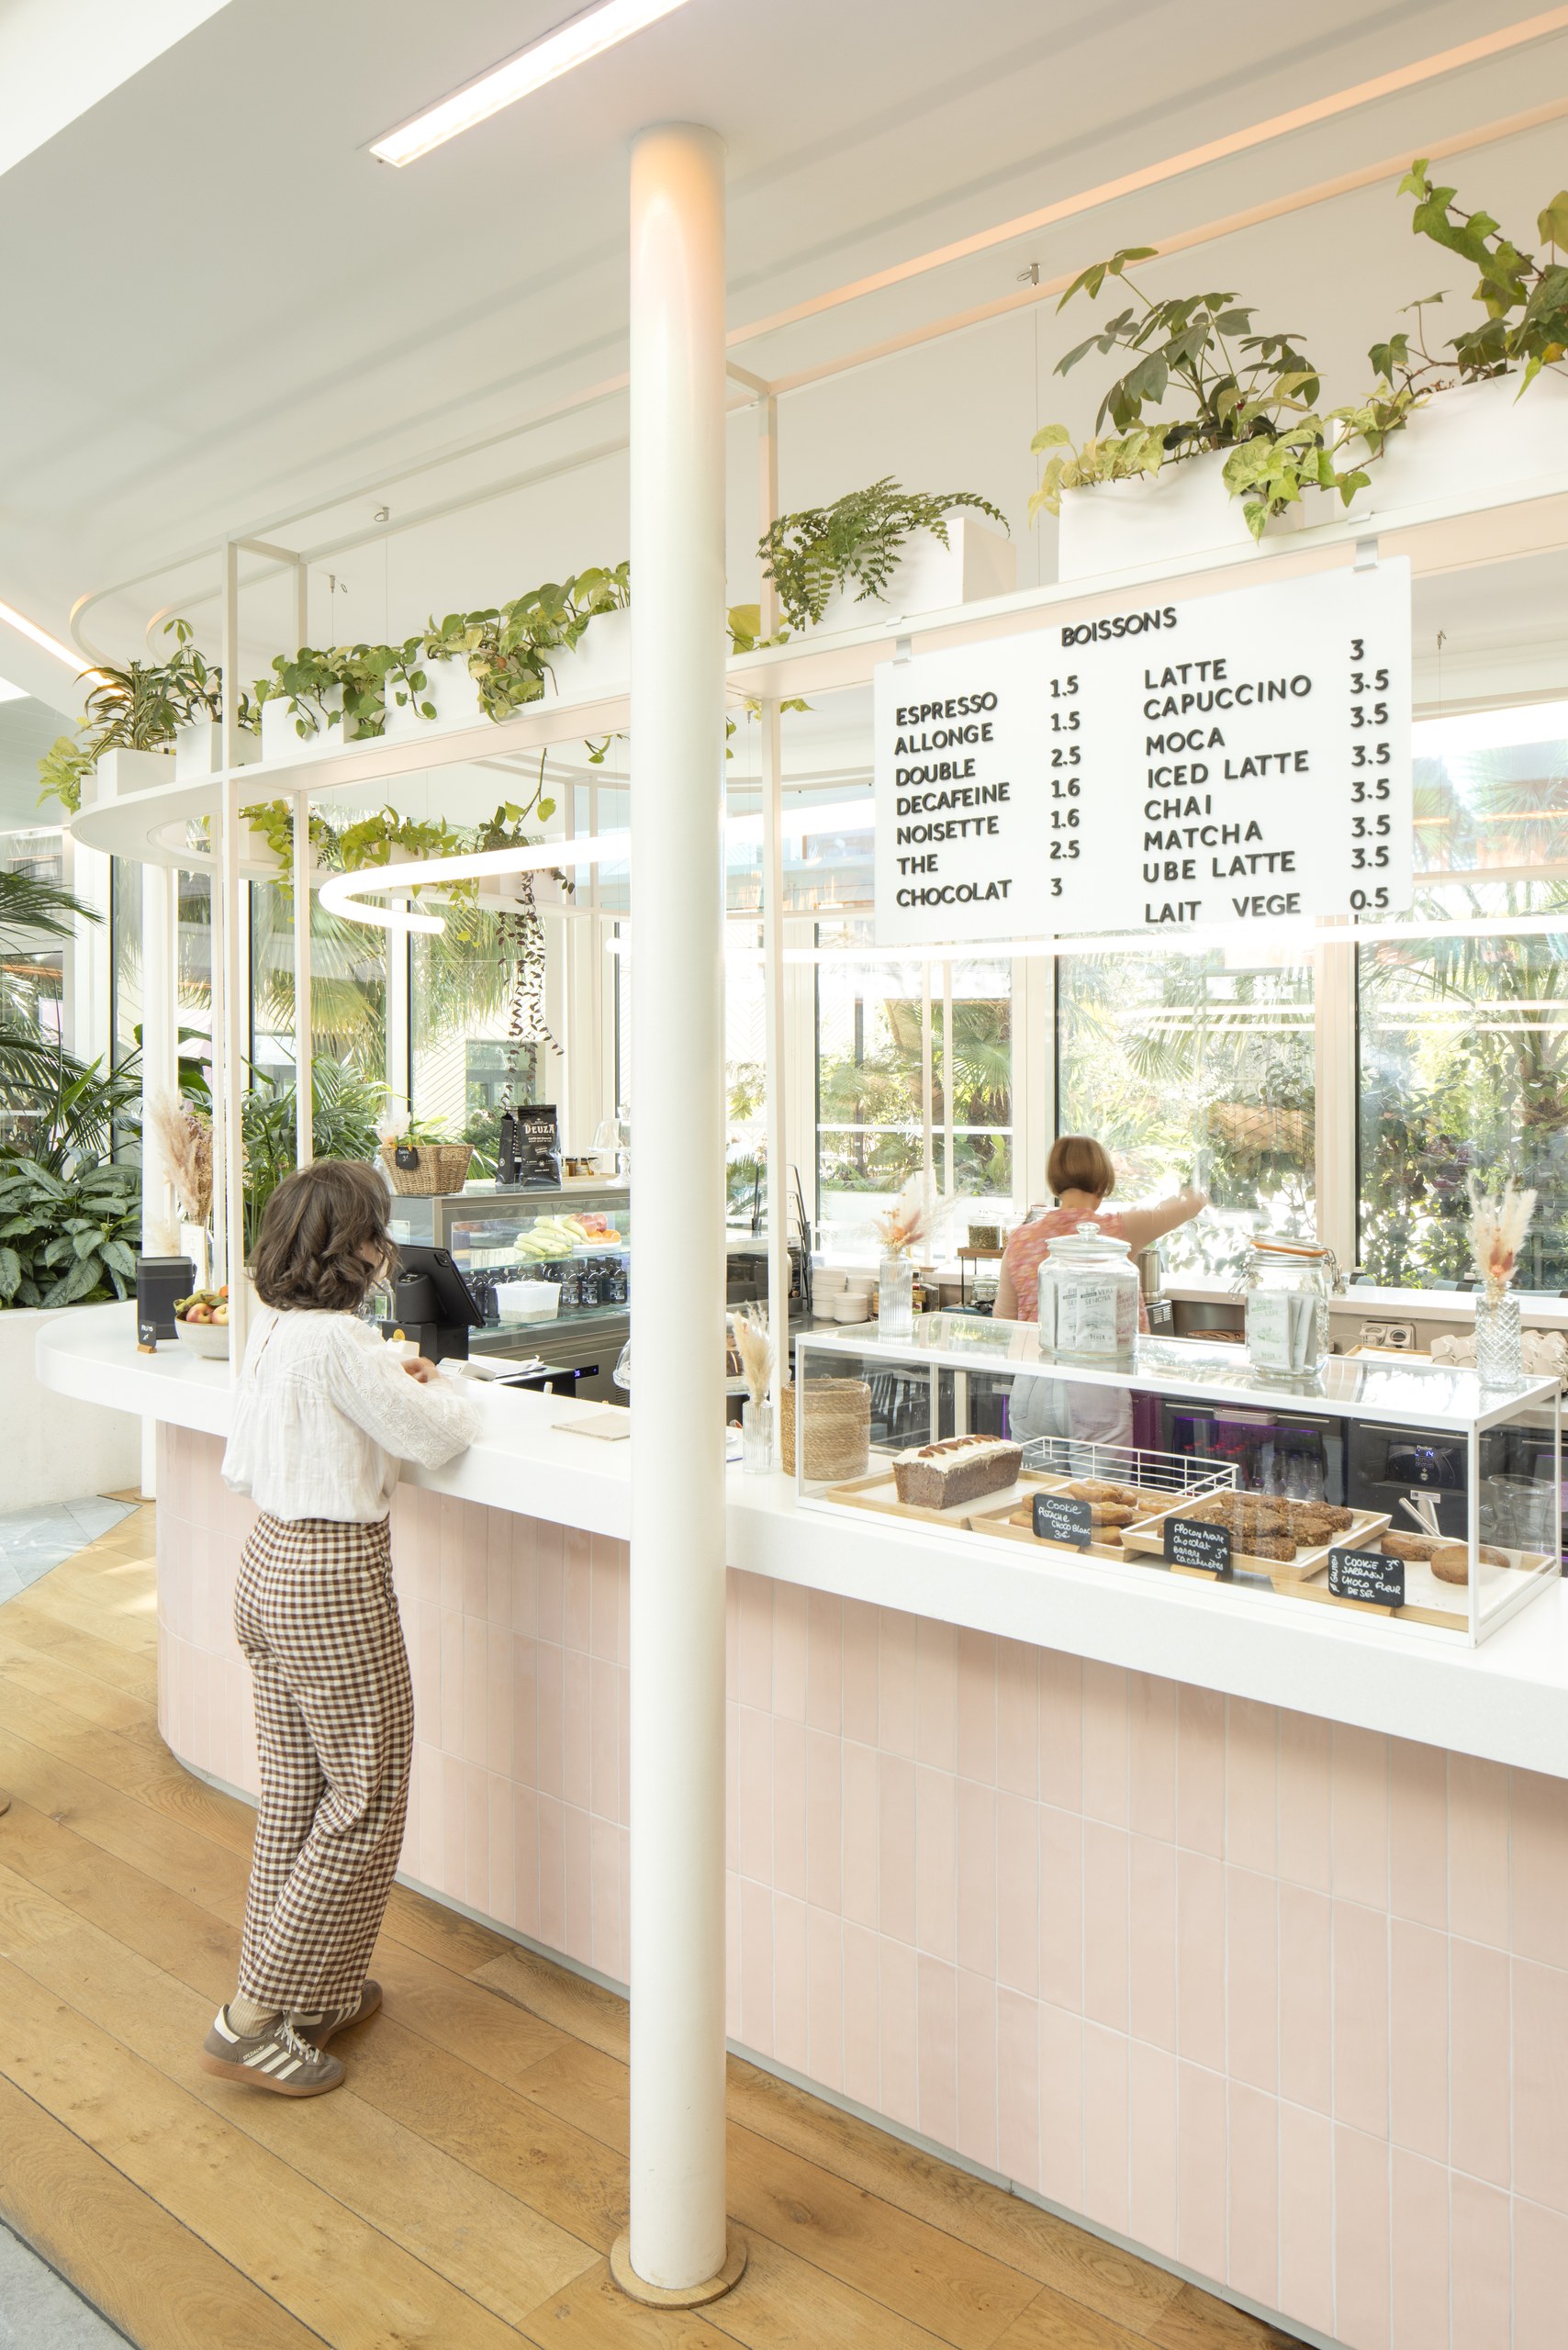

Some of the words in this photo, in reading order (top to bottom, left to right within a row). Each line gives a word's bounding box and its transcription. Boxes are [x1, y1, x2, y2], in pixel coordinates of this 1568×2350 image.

[1062, 607, 1177, 646] BOISSONS
[1146, 659, 1227, 689] LATTE
[1350, 639, 1364, 661] 3
[896, 692, 998, 726] ESPRESSO
[1049, 676, 1079, 698] 1.5
[1144, 675, 1312, 720] CAPUCCINO
[1350, 669, 1389, 694] 3.5
[894, 722, 994, 755] ALLONGE
[1050, 711, 1081, 732] 1.5
[1146, 727, 1225, 755] MOCA
[1350, 702, 1389, 727] 3.5
[896, 758, 976, 787] DOUBLE
[1051, 746, 1081, 767] 2.5
[1148, 764, 1209, 789] ICED
[1225, 750, 1309, 780] LATTE
[1351, 743, 1391, 767] 3.5
[896, 782, 1011, 815] DECAFEINE
[1051, 778, 1081, 799] 1.6
[1144, 795, 1212, 821] CHAI
[1350, 778, 1390, 802] 3.5
[896, 816, 1000, 845] NOISETTE
[1051, 809, 1081, 829] 1.6
[1144, 821, 1263, 851] MATCHA
[1351, 814, 1391, 837] 3.5
[897, 854, 939, 876] THE
[1049, 840, 1081, 860] 2.5
[1143, 859, 1196, 883] UBE
[1212, 851, 1296, 878] LATTE
[1350, 845, 1390, 869] 3.5
[896, 879, 1013, 907] CHOCOLAT
[1050, 878, 1063, 897] 3
[1145, 901, 1202, 923] LAIT
[1232, 892, 1301, 917] VEGE
[1350, 888, 1389, 911] 0.5
[524, 1125, 555, 1135] DEUZA
[1084, 1294, 1112, 1305] SENCHA
[1047, 1500, 1081, 1515] Cookie
[1054, 1529, 1070, 1539] 3€
[1341, 1575, 1370, 1588] CHOCO
[1384, 1559, 1401, 1571] 3€
[1347, 1586, 1359, 1595] DE
